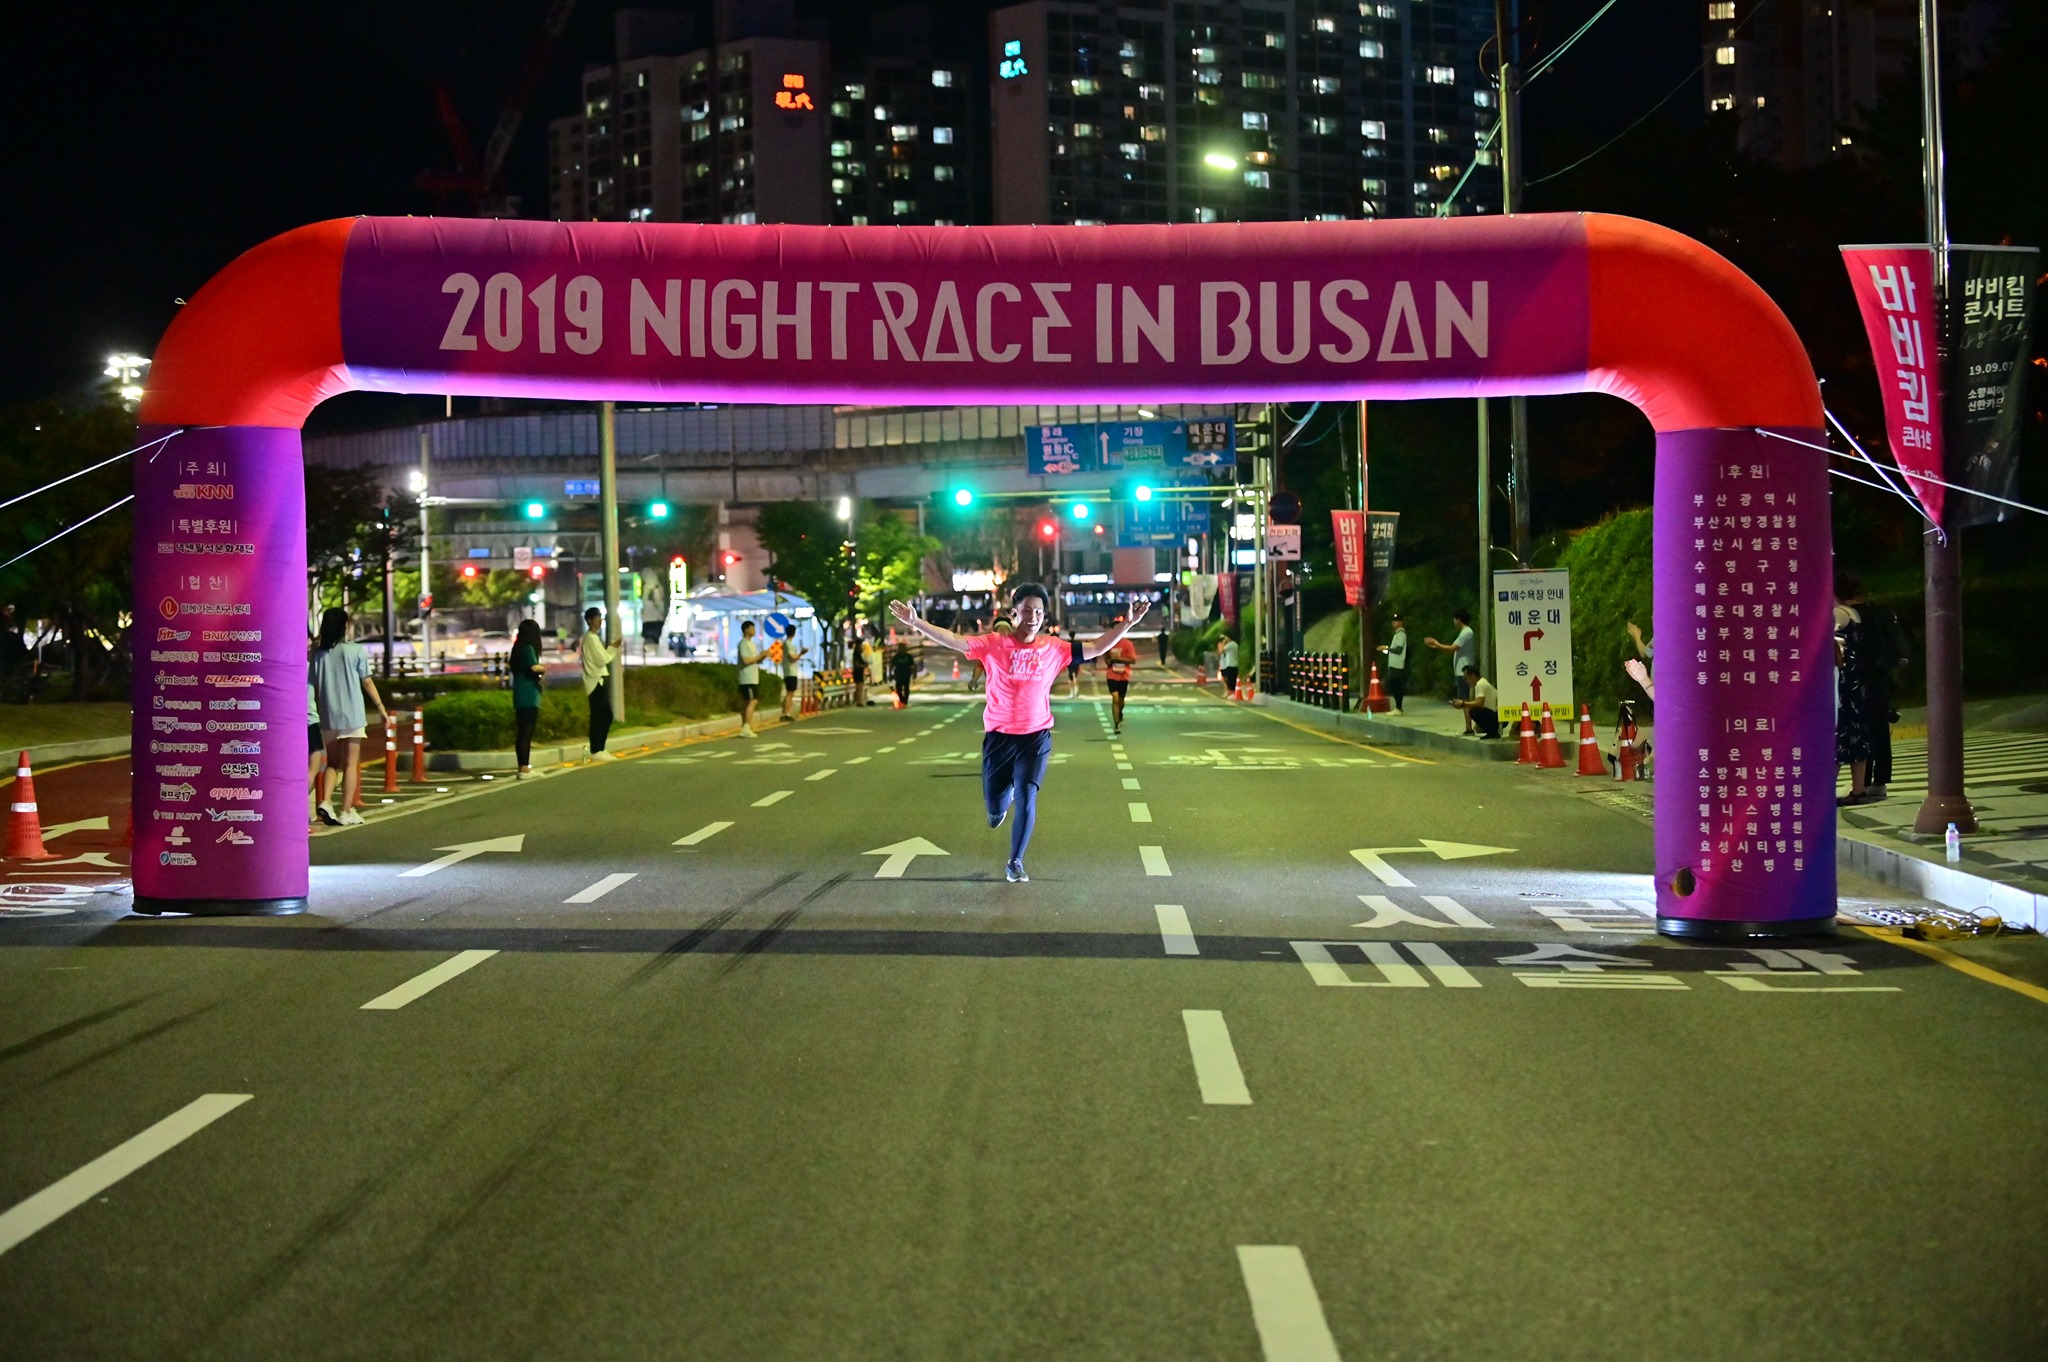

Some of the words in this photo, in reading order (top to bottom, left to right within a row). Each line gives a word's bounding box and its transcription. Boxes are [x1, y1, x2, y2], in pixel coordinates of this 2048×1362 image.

[1964, 275, 2025, 300] 바비킴
[1964, 298, 2026, 325] 콘서트
[439, 272, 604, 356] 2019
[630, 278, 860, 361] NIGHT
[872, 280, 1072, 363] RACE
[1096, 283, 1175, 363] IN
[1200, 279, 1489, 366] BUSAN
[1868, 265, 1930, 425] 바비킴
[1124, 427, 1143, 437] 기장
[1189, 423, 1226, 434] 해운대
[196, 484, 234, 499] KNN
[178, 519, 231, 534] 특별후원
[1694, 515, 1797, 529] 부산지방경찰청
[1694, 538, 1798, 551] 부산시설공단
[1511, 589, 1543, 601] 해수욕장
[1547, 588, 1564, 600] 안내
[1695, 582, 1798, 596] 해운대구청
[1508, 609, 1560, 625] 해운대
[1696, 604, 1799, 618] 해운대경찰서
[1696, 626, 1799, 640] 남부경찰서
[1009, 648, 1043, 660] NIGHT
[1697, 649, 1800, 662] 신라대학교
[1009, 660, 1044, 674] RACE
[1697, 671, 1801, 685] 동의대학교
[210, 701, 235, 710] KRX
[221, 763, 259, 775] 삼진어묵
[1699, 766, 1802, 780] 소방재난본부
[1289, 938, 1903, 992] 미술관
